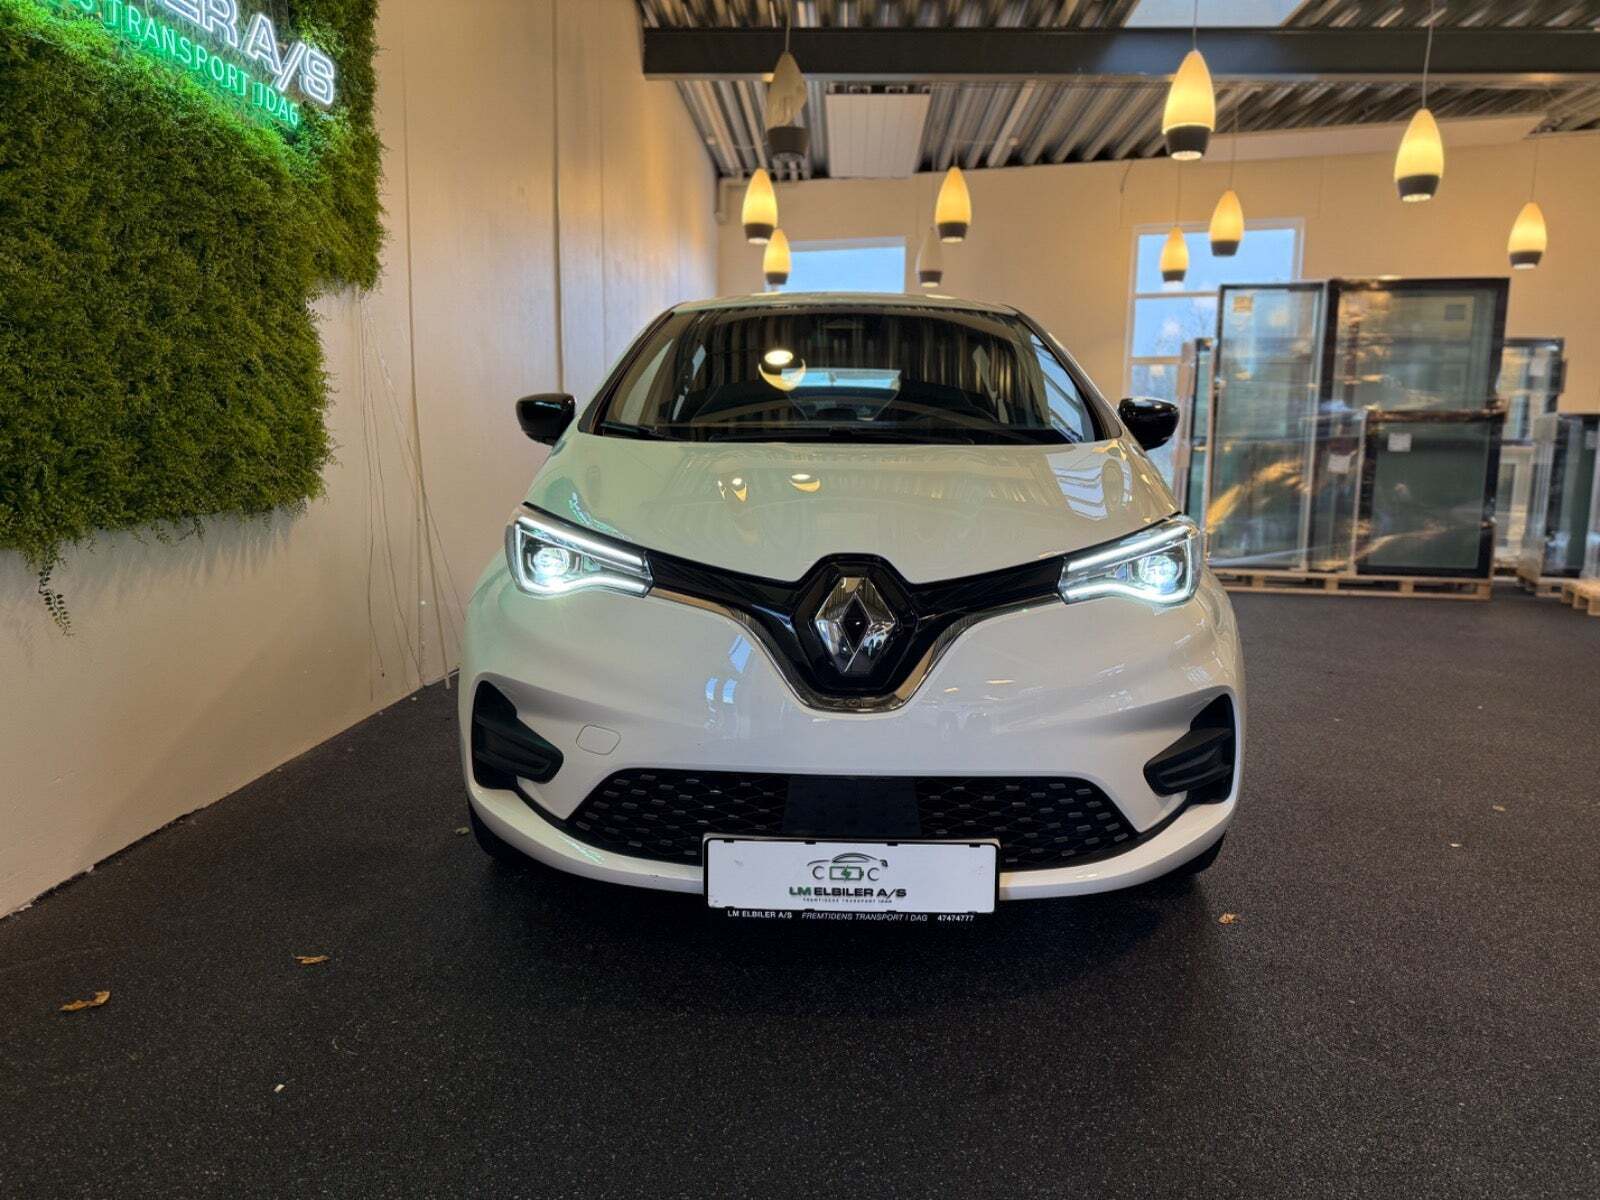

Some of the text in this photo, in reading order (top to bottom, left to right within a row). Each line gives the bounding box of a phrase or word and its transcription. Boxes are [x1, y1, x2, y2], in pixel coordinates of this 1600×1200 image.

[105, 0, 249, 96] TRANSPORT
[246, 12, 335, 105] A/S
[742, 911, 776, 919] ELBILER
[855, 913, 903, 921] TRANSPORT
[789, 886, 907, 899] LM ELBILER A/S
